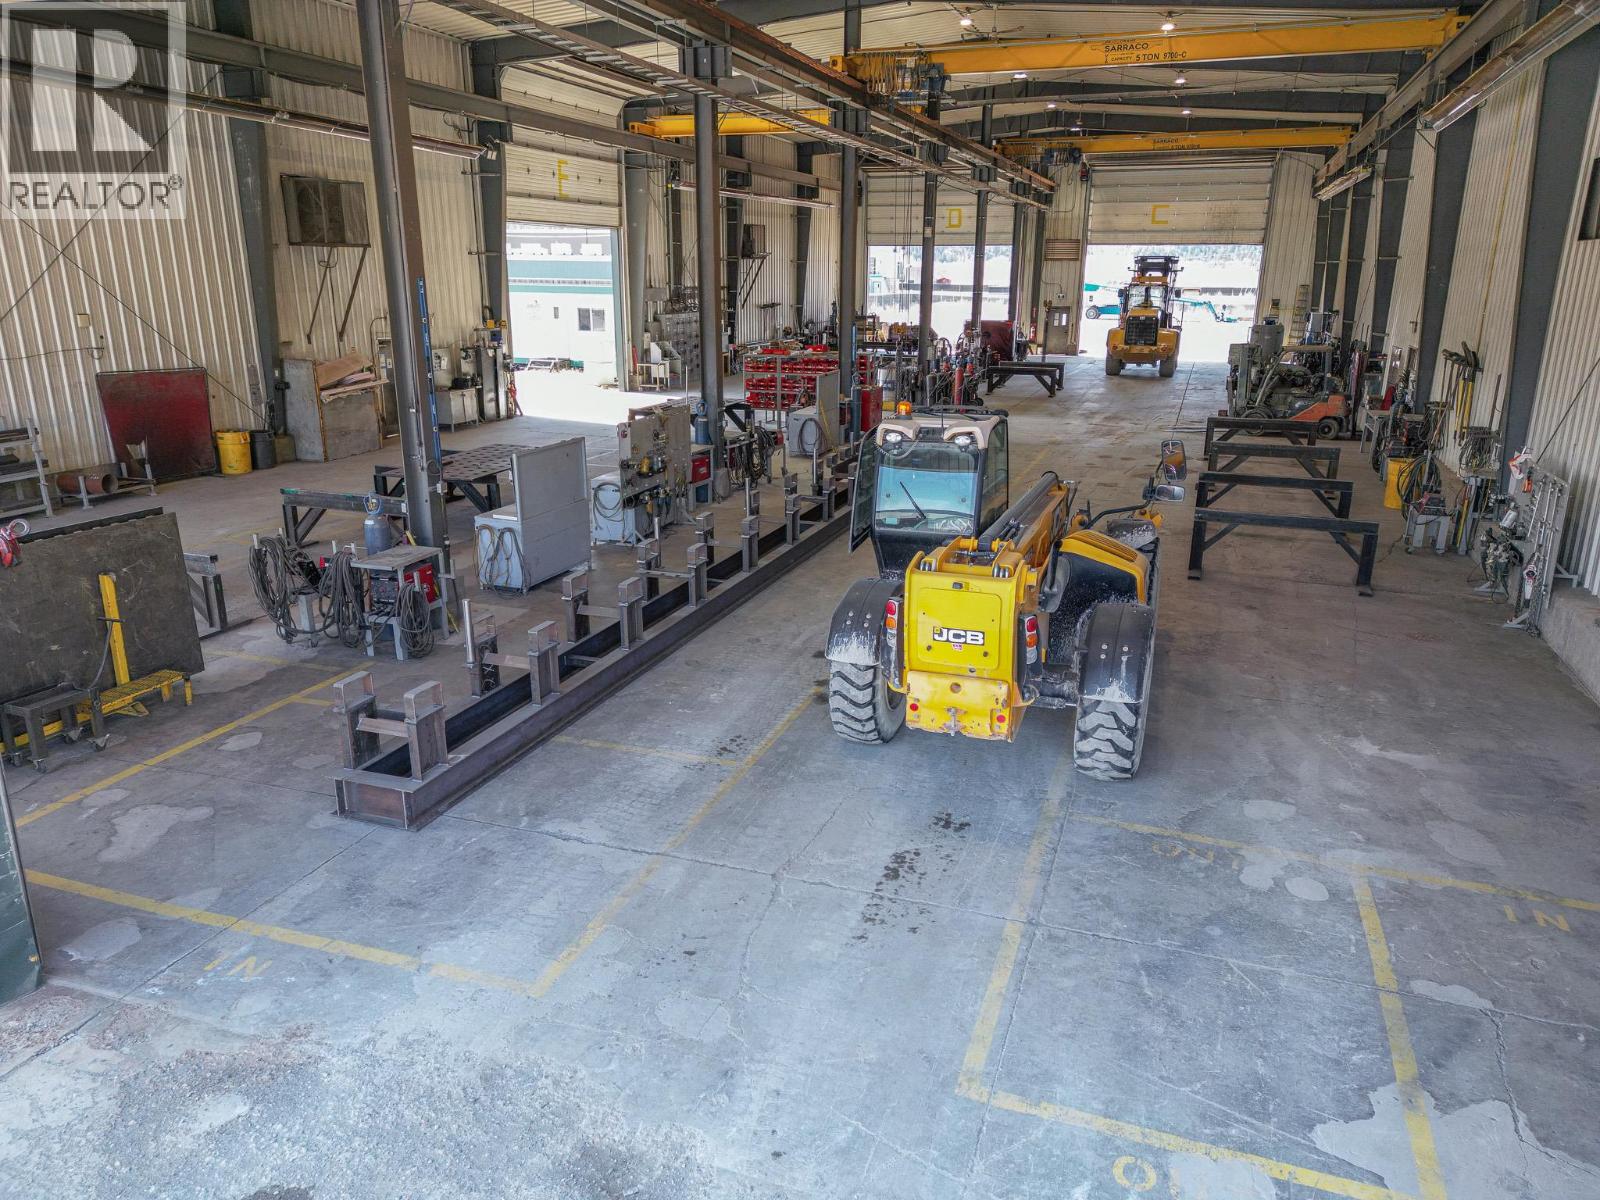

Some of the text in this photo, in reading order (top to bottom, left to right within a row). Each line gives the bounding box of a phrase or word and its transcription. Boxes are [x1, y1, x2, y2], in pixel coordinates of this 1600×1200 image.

[1104, 43, 1148, 53] SARRACO
[1142, 53, 1160, 61] TON
[557, 159, 569, 199] E
[945, 208, 963, 229] D
[1151, 204, 1169, 225] C
[934, 626, 984, 645] JCB
